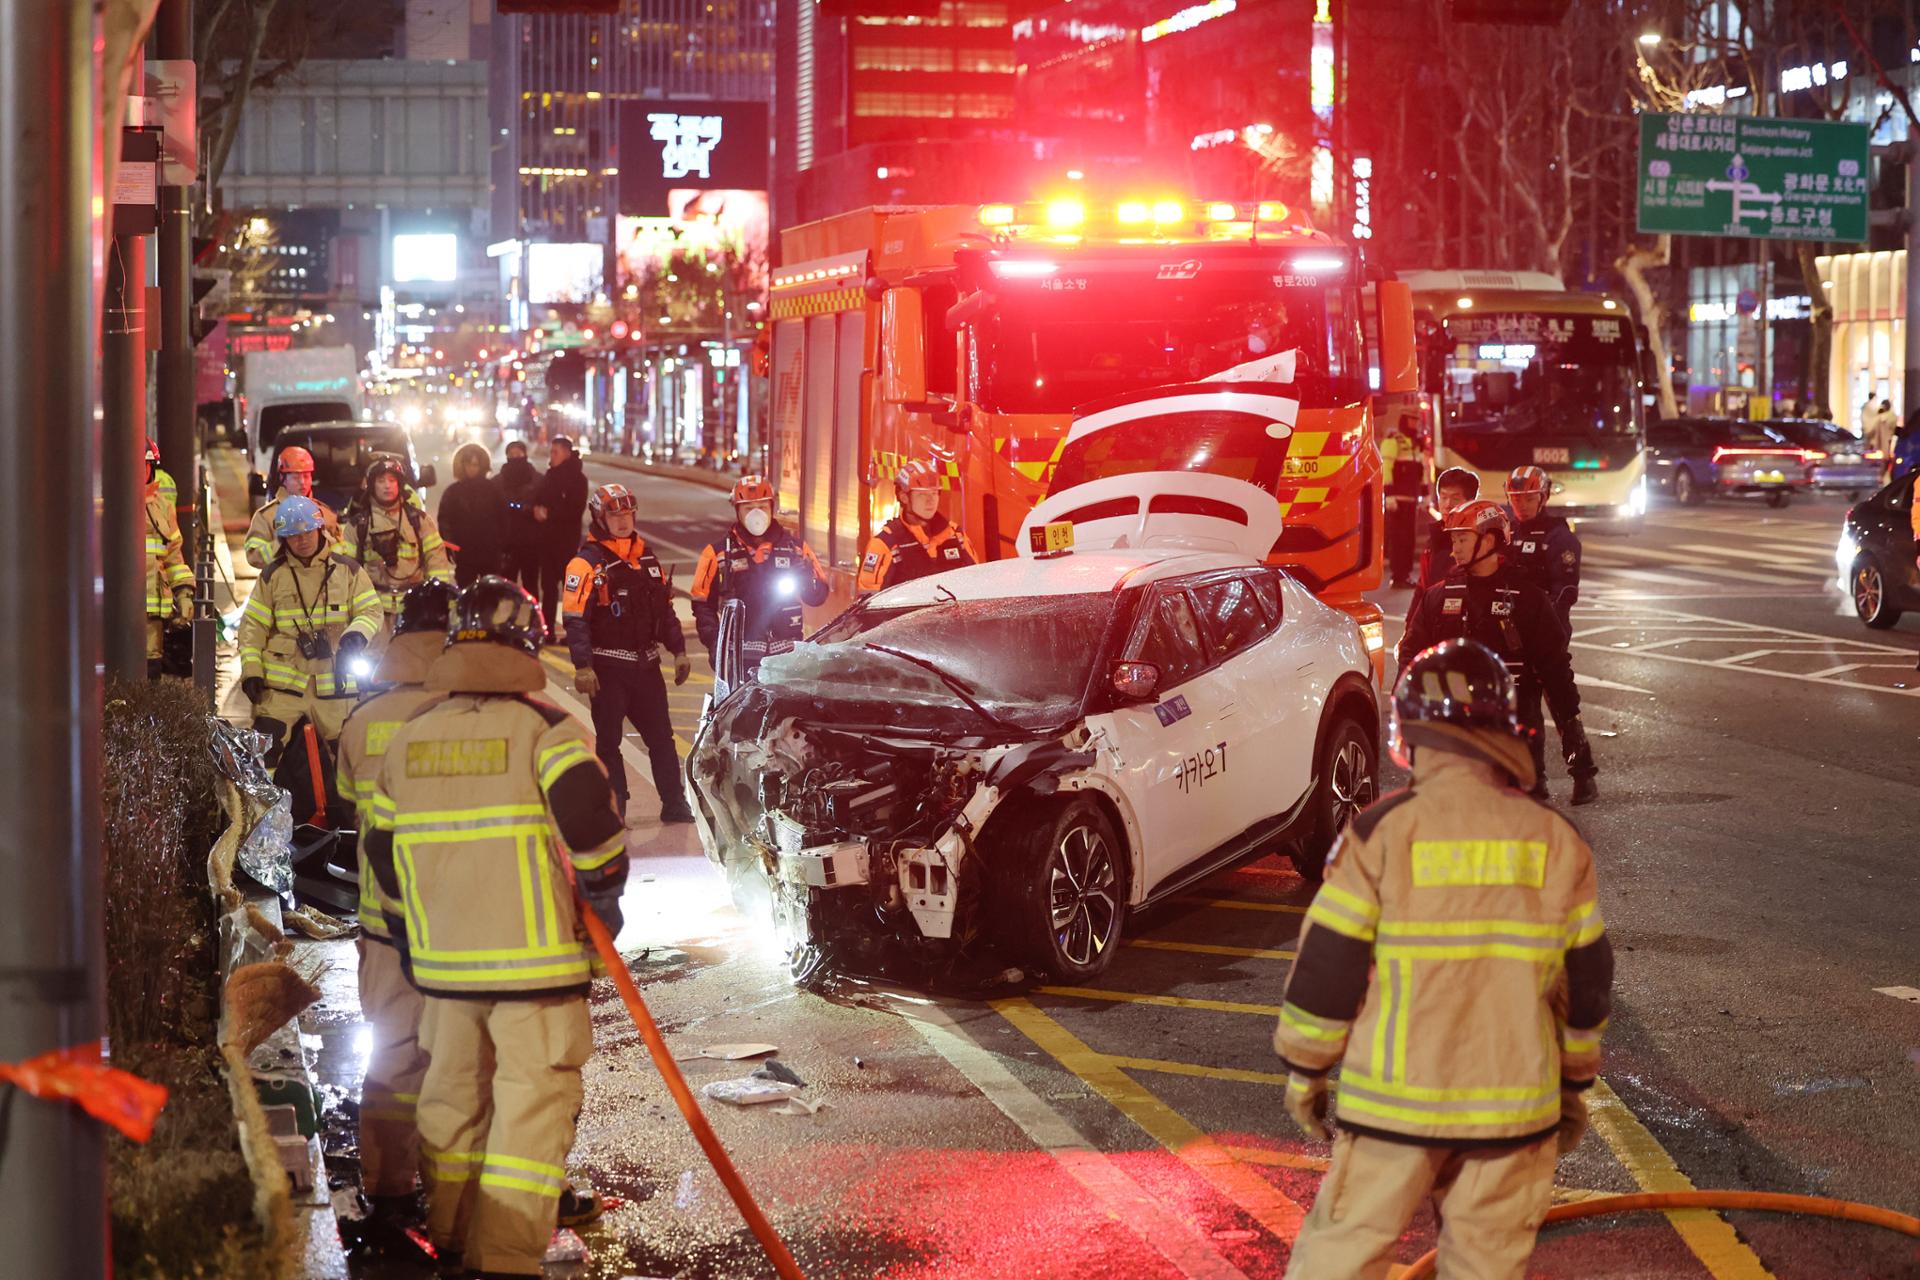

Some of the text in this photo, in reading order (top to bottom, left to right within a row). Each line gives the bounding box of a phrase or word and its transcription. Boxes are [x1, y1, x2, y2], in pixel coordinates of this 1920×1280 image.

[1667, 115, 1737, 133] 신촌로터리
[1656, 132, 1736, 152] 세종대로사거리
[1784, 173, 1829, 192] 광화문
[1771, 206, 1832, 226] 종로구청
[1041, 278, 1087, 291] 서울소방
[1272, 275, 1317, 288] 종로200
[1176, 741, 1227, 794] 카카오T
